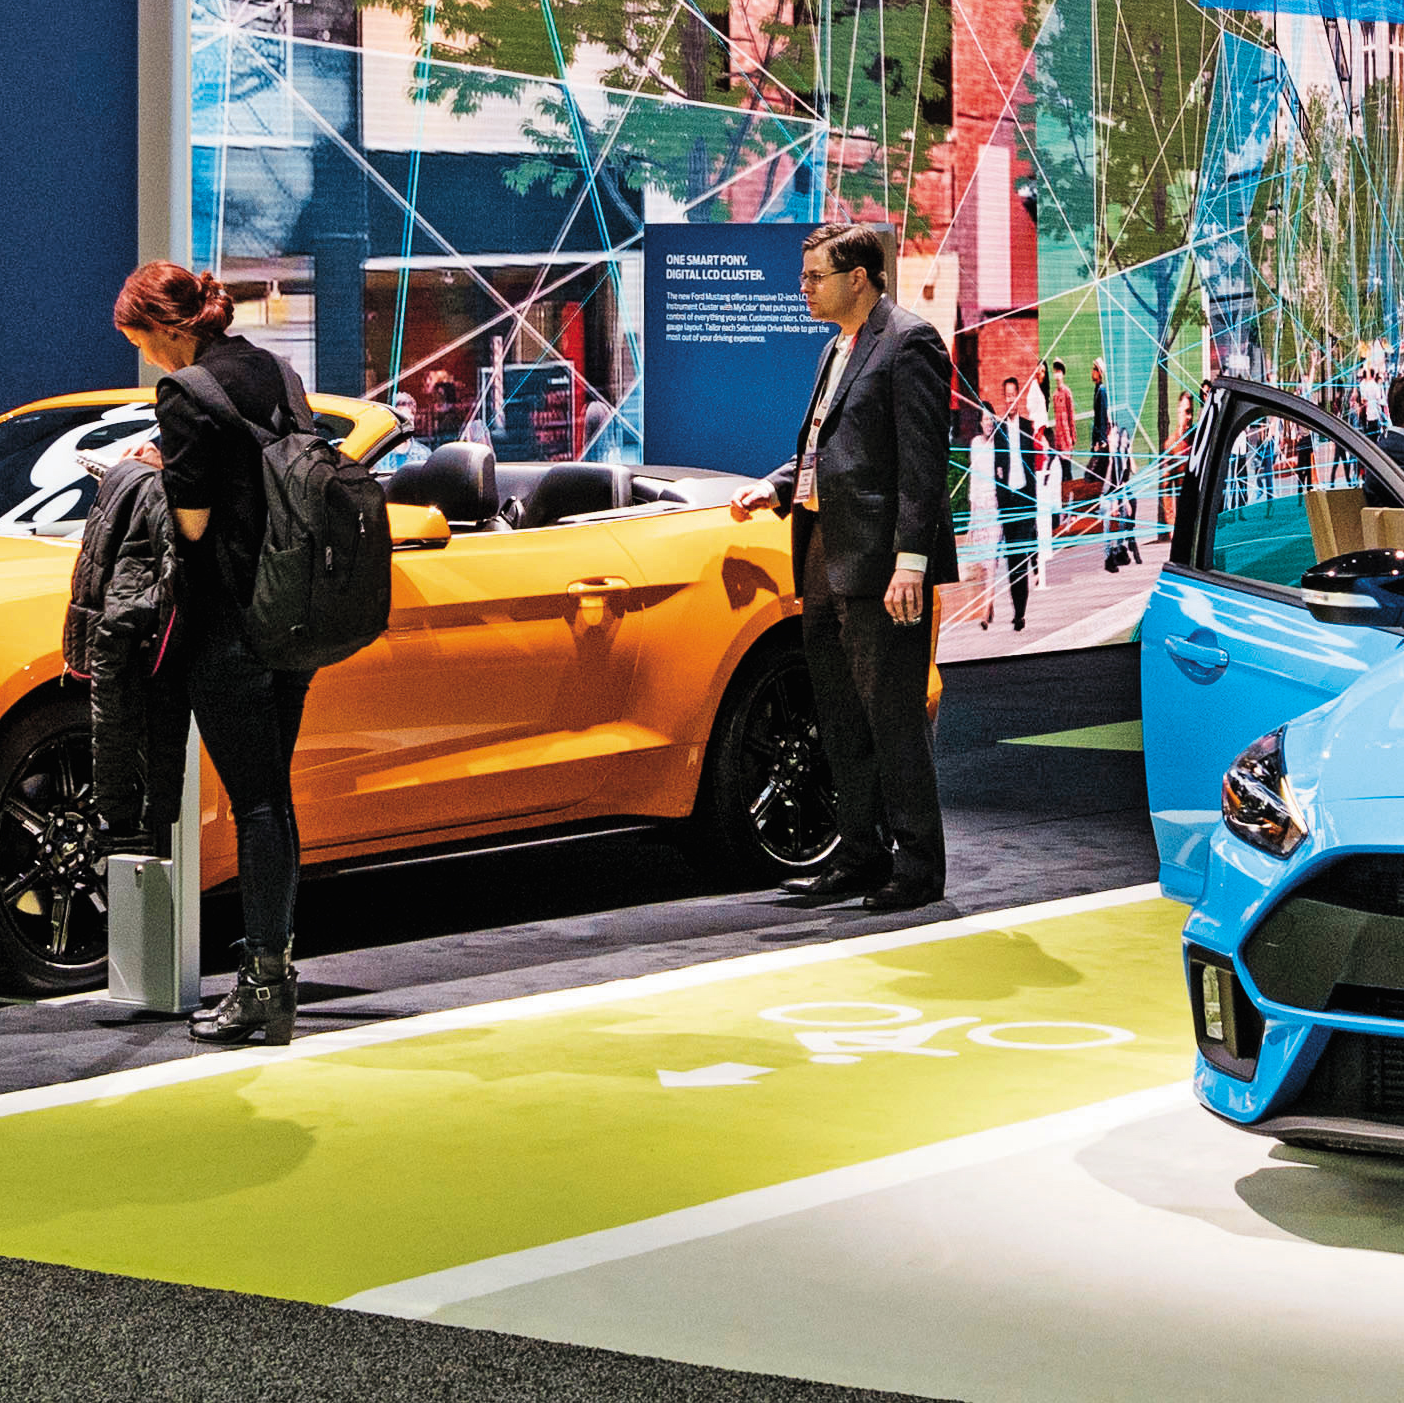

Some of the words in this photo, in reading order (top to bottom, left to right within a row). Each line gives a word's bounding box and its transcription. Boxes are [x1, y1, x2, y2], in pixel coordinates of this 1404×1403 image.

[666, 254, 686, 266] ONE
[686, 254, 719, 266] SMART
[720, 254, 749, 266] PONY.
[666, 268, 701, 280] DIGITAL
[702, 268, 720, 280] LCD
[721, 269, 766, 281] CLUSTER.
[666, 291, 678, 300] The
[691, 292, 705, 300] Ford
[705, 292, 731, 303] Mustang
[666, 302, 699, 310] Instrument
[699, 303, 719, 311] Cluster
[773, 304, 787, 313] puts
[787, 305, 799, 313] you
[687, 313, 694, 321] of
[725, 315, 737, 323] you
[767, 324, 783, 333] Drive
[783, 324, 800, 333] Mode
[801, 325, 807, 333] to
[808, 326, 818, 335] get
[818, 325, 830, 334] the
[700, 335, 712, 343] your
